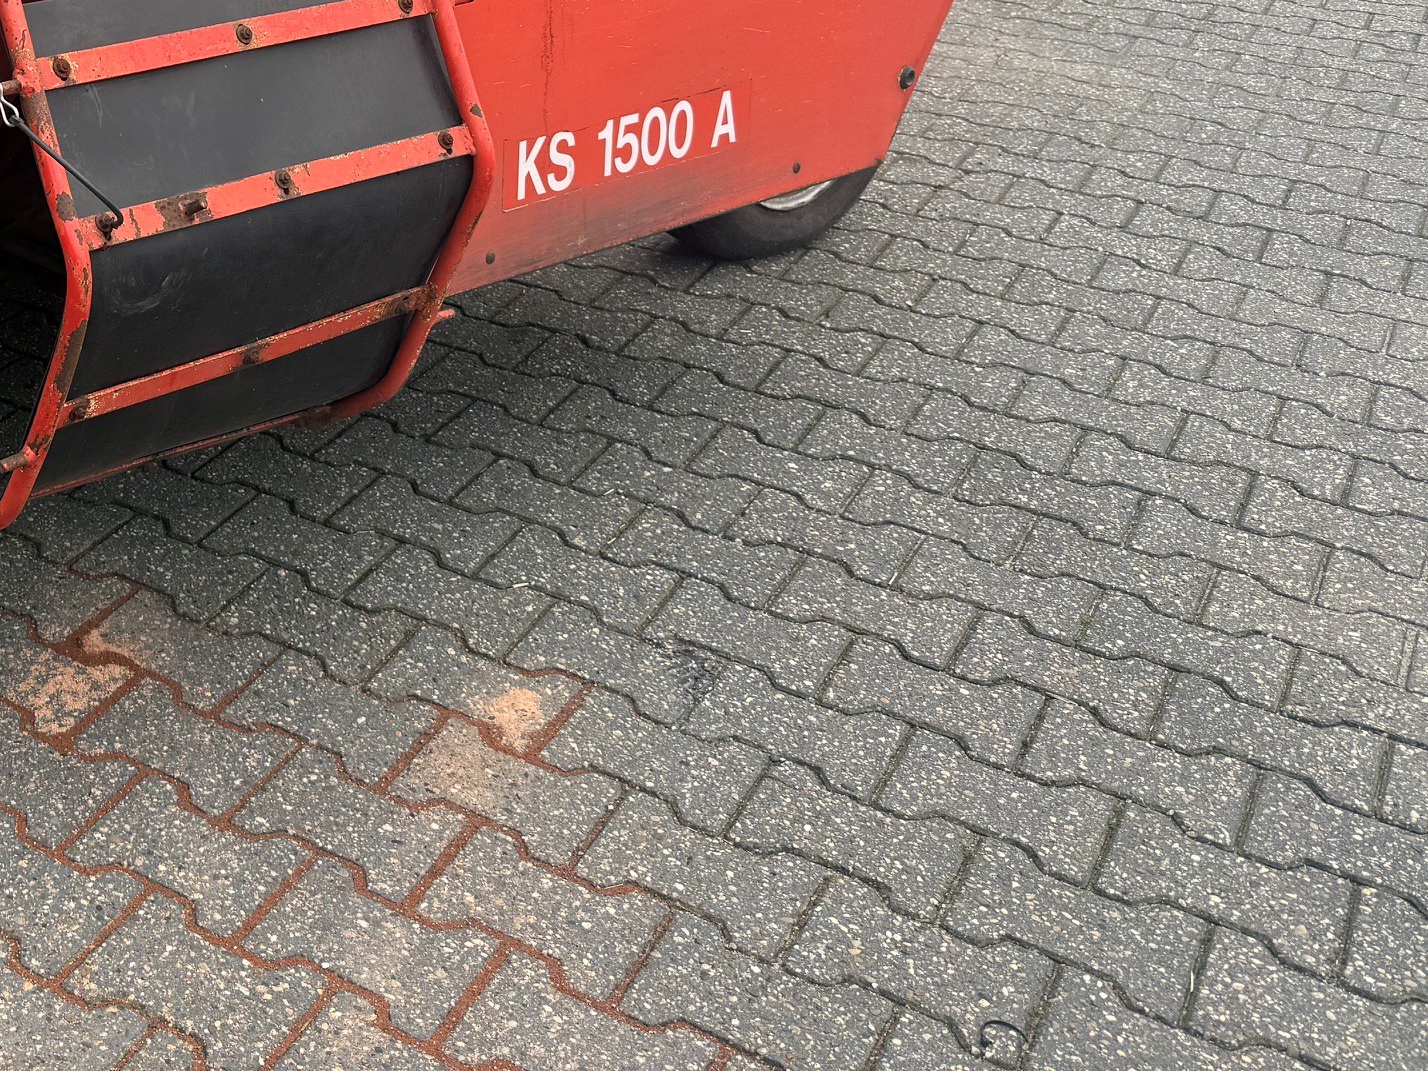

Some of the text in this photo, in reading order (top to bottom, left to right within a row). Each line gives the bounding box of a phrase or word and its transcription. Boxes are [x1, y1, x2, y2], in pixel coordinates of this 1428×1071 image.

[517, 89, 737, 201] KS 1500 A
